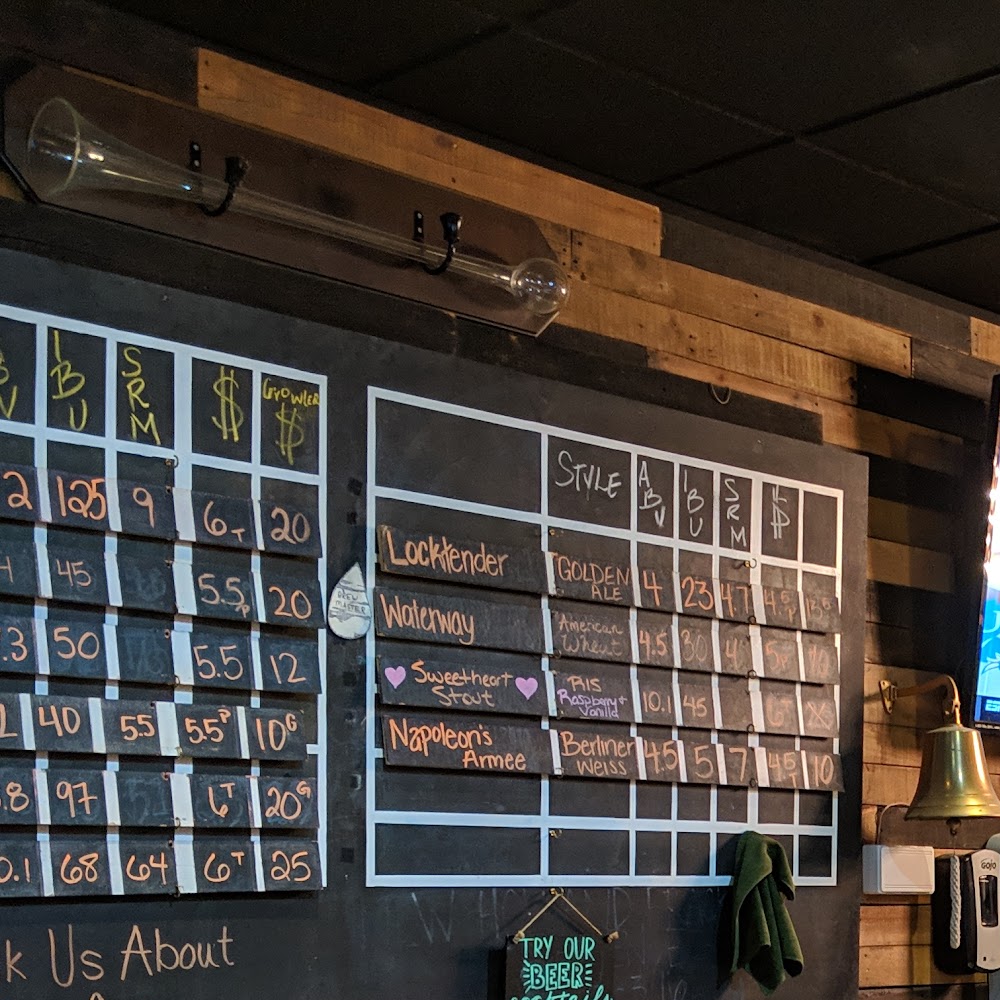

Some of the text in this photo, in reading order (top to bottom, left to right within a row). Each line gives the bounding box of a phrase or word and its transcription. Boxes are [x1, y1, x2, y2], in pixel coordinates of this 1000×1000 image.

[555, 450, 621, 498] STYLE
[57, 475, 107, 520] 125
[132, 487, 155, 528] 9
[270, 507, 311, 544] 20
[386, 530, 510, 577] Locktender
[558, 556, 629, 586] GOLDEN
[57, 560, 312, 619] 45 20
[591, 584, 622, 600] ALE
[643, 571, 749, 617] 4 23 4.7
[380, 594, 475, 645] Waterway
[559, 613, 623, 635] American
[53, 627, 100, 660] 50
[193, 645, 244, 681] 5.5
[270, 652, 306, 685] 12
[639, 629, 667, 660] 4.5
[681, 630, 707, 661] 30
[411, 659, 513, 687] Sweetheart
[432, 685, 495, 707] Stout
[643, 691, 707, 717] 10.1 45
[38, 704, 80, 737] 40
[389, 718, 493, 756] Napoleon's
[462, 750, 526, 771] Armee
[560, 731, 635, 757] Berliner
[644, 740, 834, 787] 4.5 5 7 10
[56, 780, 97, 818] 97
[60, 853, 99, 884] 68
[126, 852, 168, 885] 64
[270, 851, 311, 882] 25
[48, 923, 105, 987] Us
[120, 924, 235, 981] About
[518, 936, 595, 961] TRY OUR
[531, 962, 584, 991] BEER
